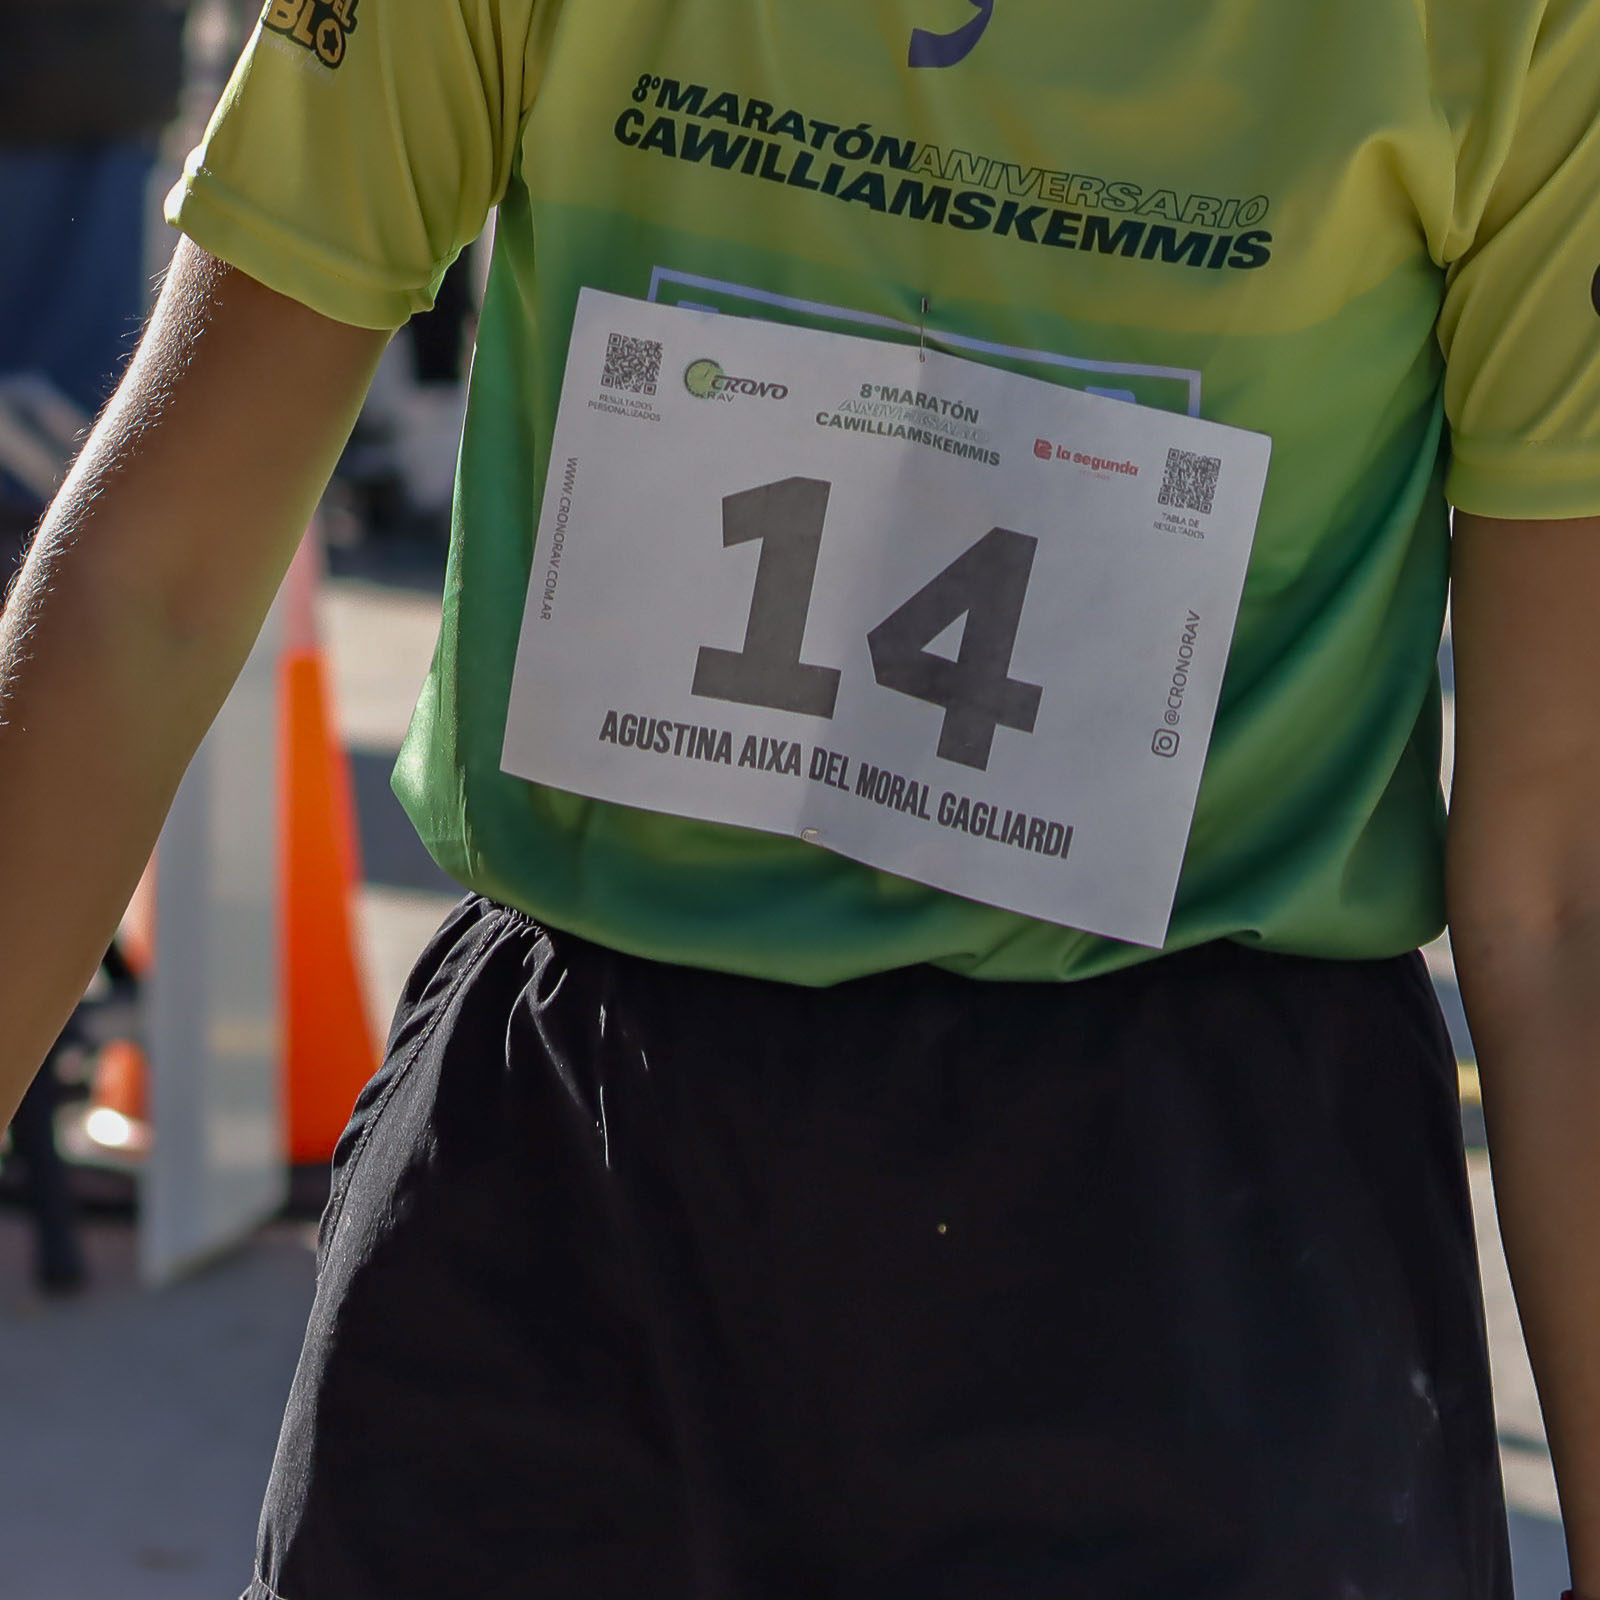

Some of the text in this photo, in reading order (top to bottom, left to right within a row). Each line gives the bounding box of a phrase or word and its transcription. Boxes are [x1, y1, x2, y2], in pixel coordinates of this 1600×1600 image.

[613, 107, 1274, 270] CAWILLIAMSKEMMIS
[599, 394, 654, 412] RESULTADOS
[706, 391, 735, 403] RAV
[711, 374, 790, 400] CRONO
[587, 400, 662, 422] PERSONALIZADOS
[815, 411, 1000, 467] CAWILLIAMSKEMMIS
[1055, 444, 1071, 461] la
[1073, 452, 1140, 477] segunda
[1153, 521, 1205, 540] RESULTADOS
[1162, 512, 1200, 528] TABLA DE
[540, 457, 578, 621] WWW.CRONORAV.COM.AR
[691, 476, 1043, 771] 14
[1163, 609, 1201, 726] @CRONORAV
[599, 710, 1075, 860] AGUSTINA AIXA DEL MORAL GAGLIARDI
